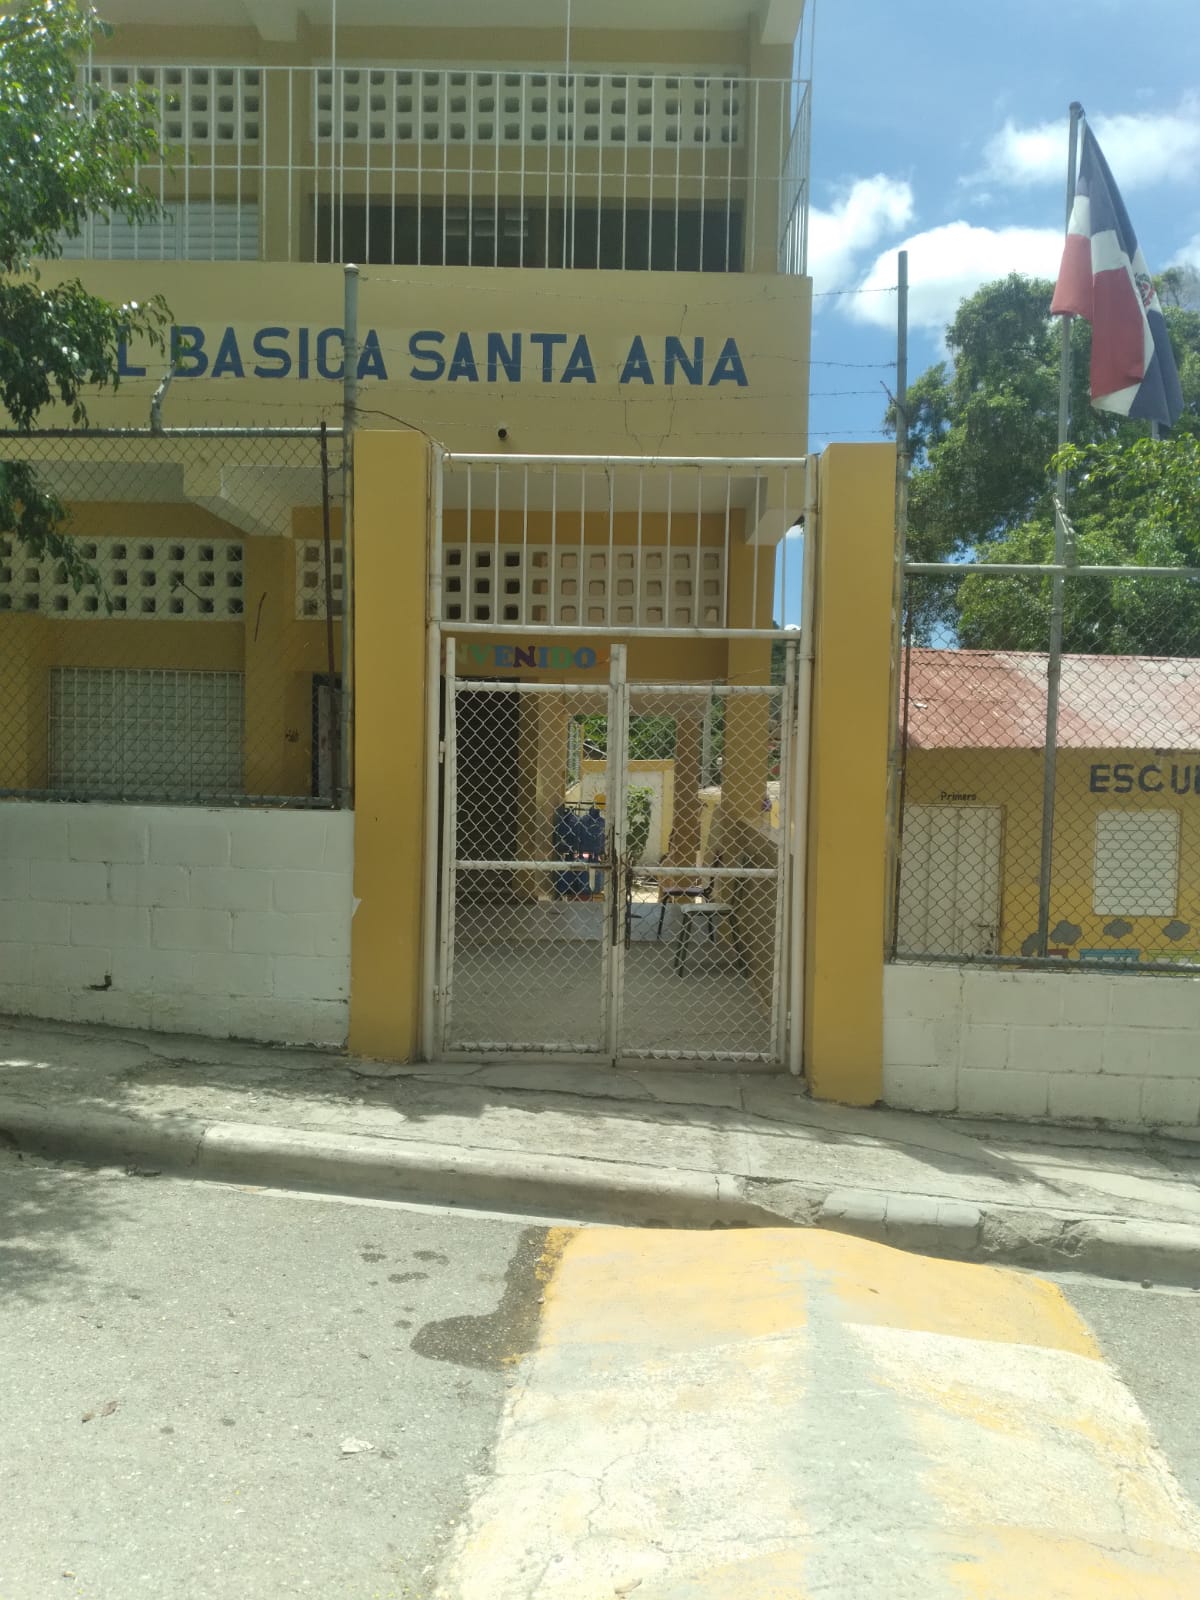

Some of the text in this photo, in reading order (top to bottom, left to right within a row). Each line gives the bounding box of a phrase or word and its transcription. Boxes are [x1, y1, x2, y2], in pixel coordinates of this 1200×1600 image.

[170, 326, 388, 380] BASICA
[408, 330, 597, 383] SANTA
[619, 335, 749, 386] ANA
[1089, 764, 1200, 795] ESCU
